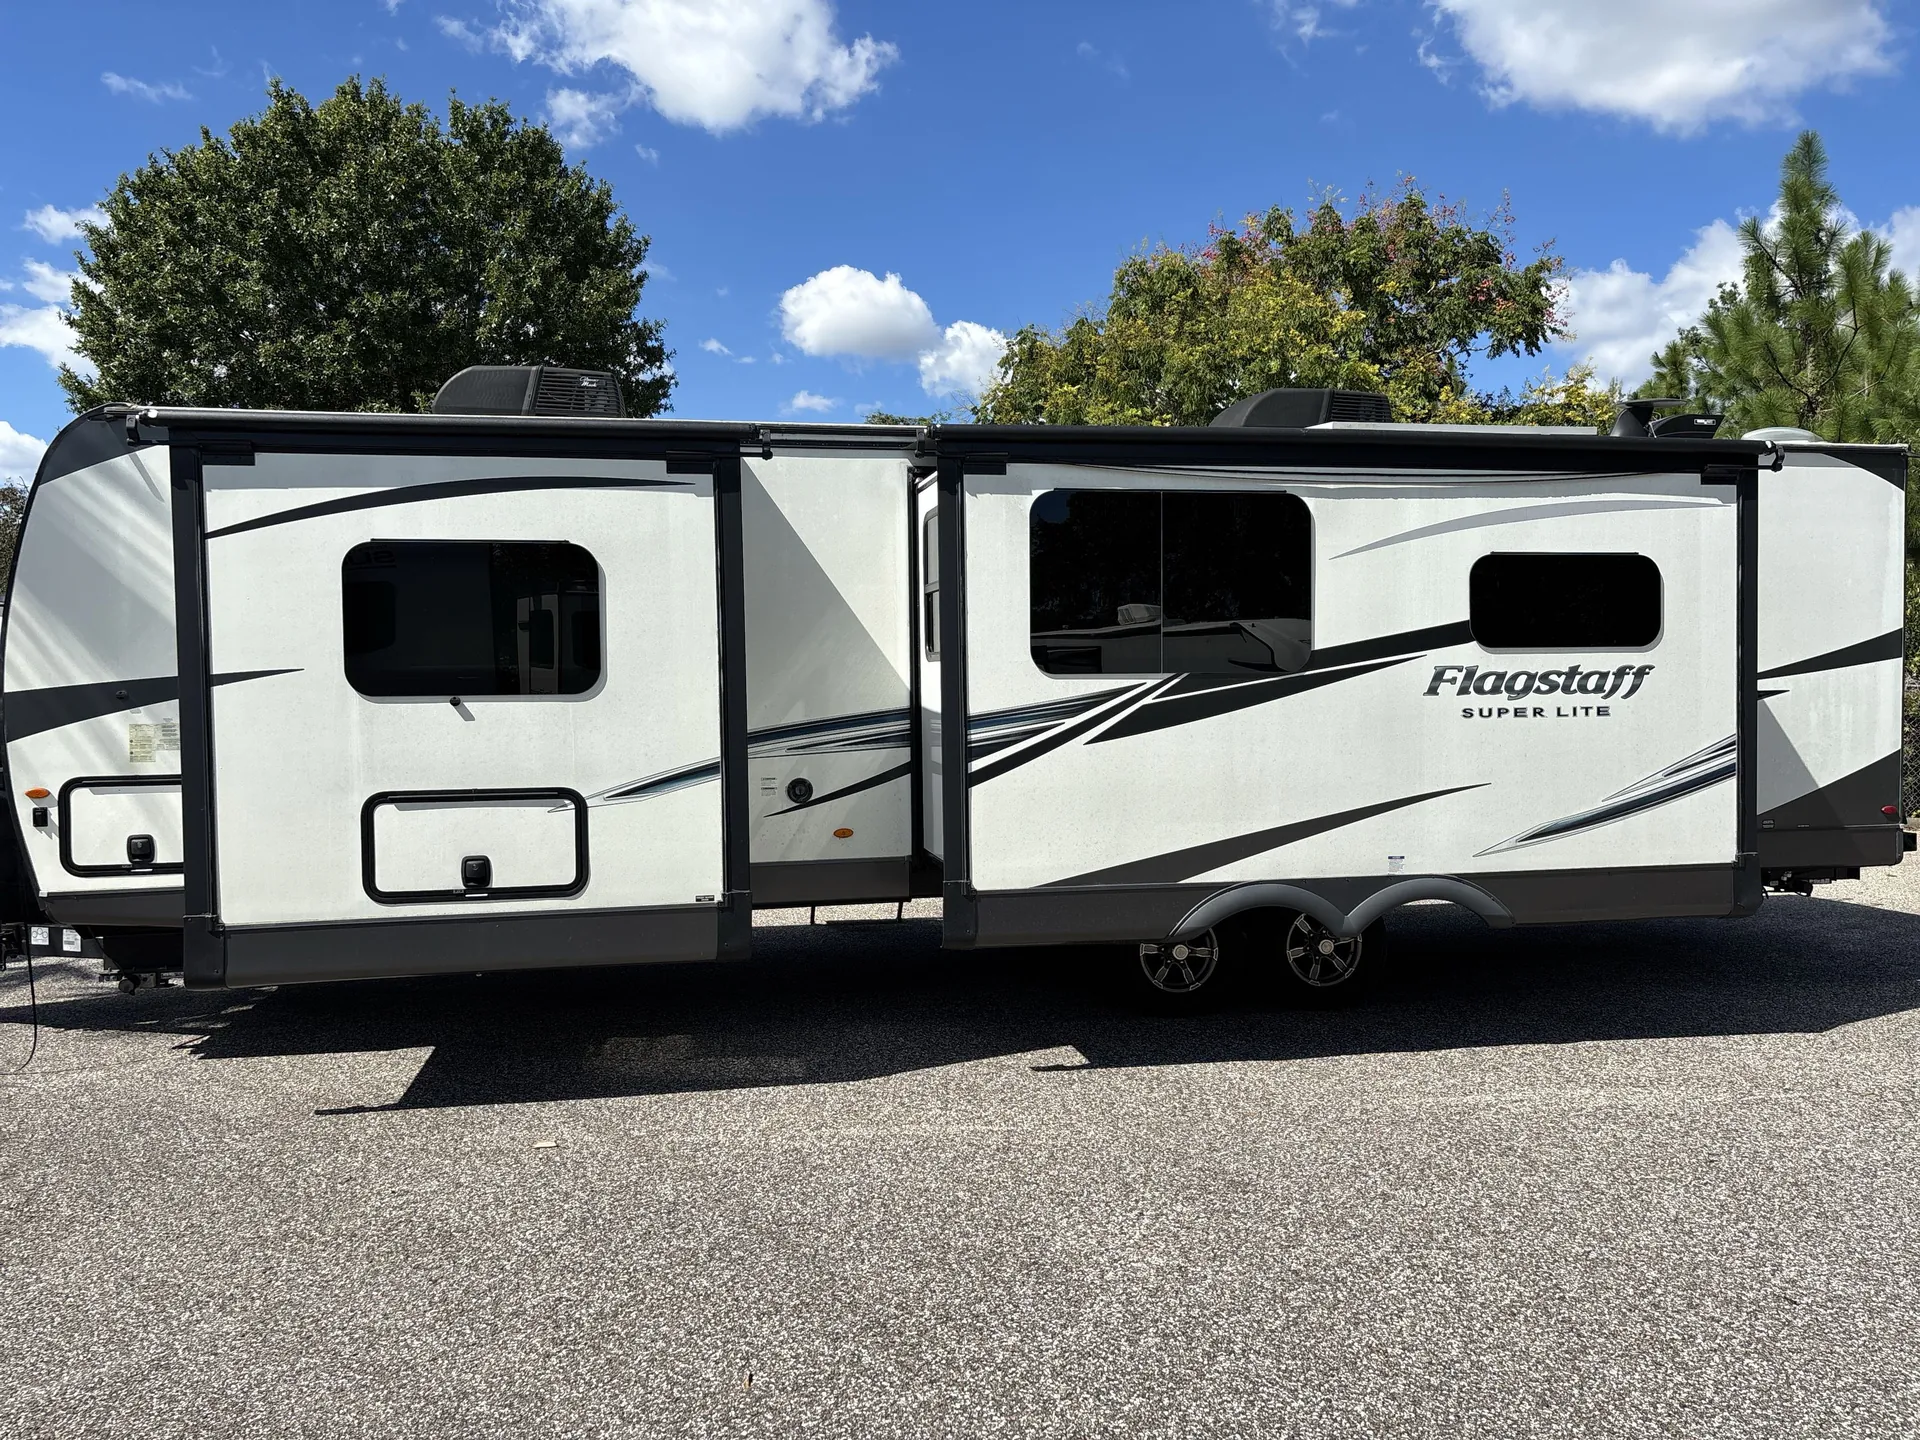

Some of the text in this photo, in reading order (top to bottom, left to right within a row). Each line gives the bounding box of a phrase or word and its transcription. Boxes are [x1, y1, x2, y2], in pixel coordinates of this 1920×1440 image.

[1423, 664, 1655, 700] Flagstaff
[1462, 706, 1610, 718] SUPER LITE
